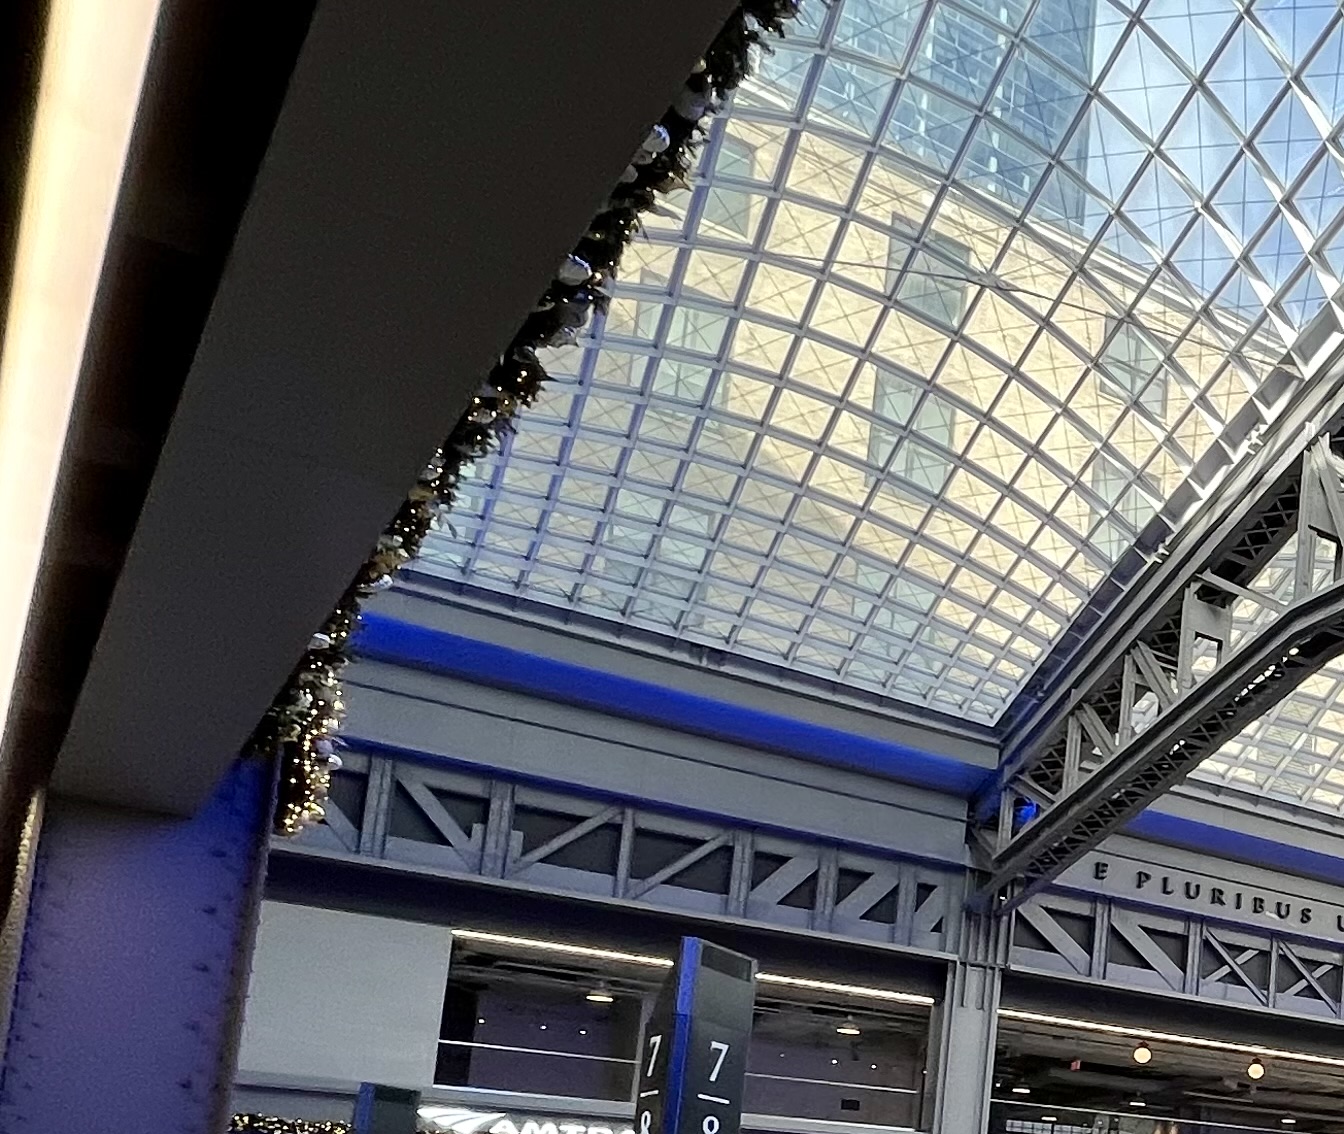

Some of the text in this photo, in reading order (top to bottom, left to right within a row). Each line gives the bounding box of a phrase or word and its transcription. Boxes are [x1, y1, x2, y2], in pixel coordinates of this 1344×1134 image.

[1093, 861, 1109, 880] E
[1136, 871, 1313, 925] PLURIBUS
[646, 1035, 662, 1077] 7
[709, 1040, 730, 1082] 7
